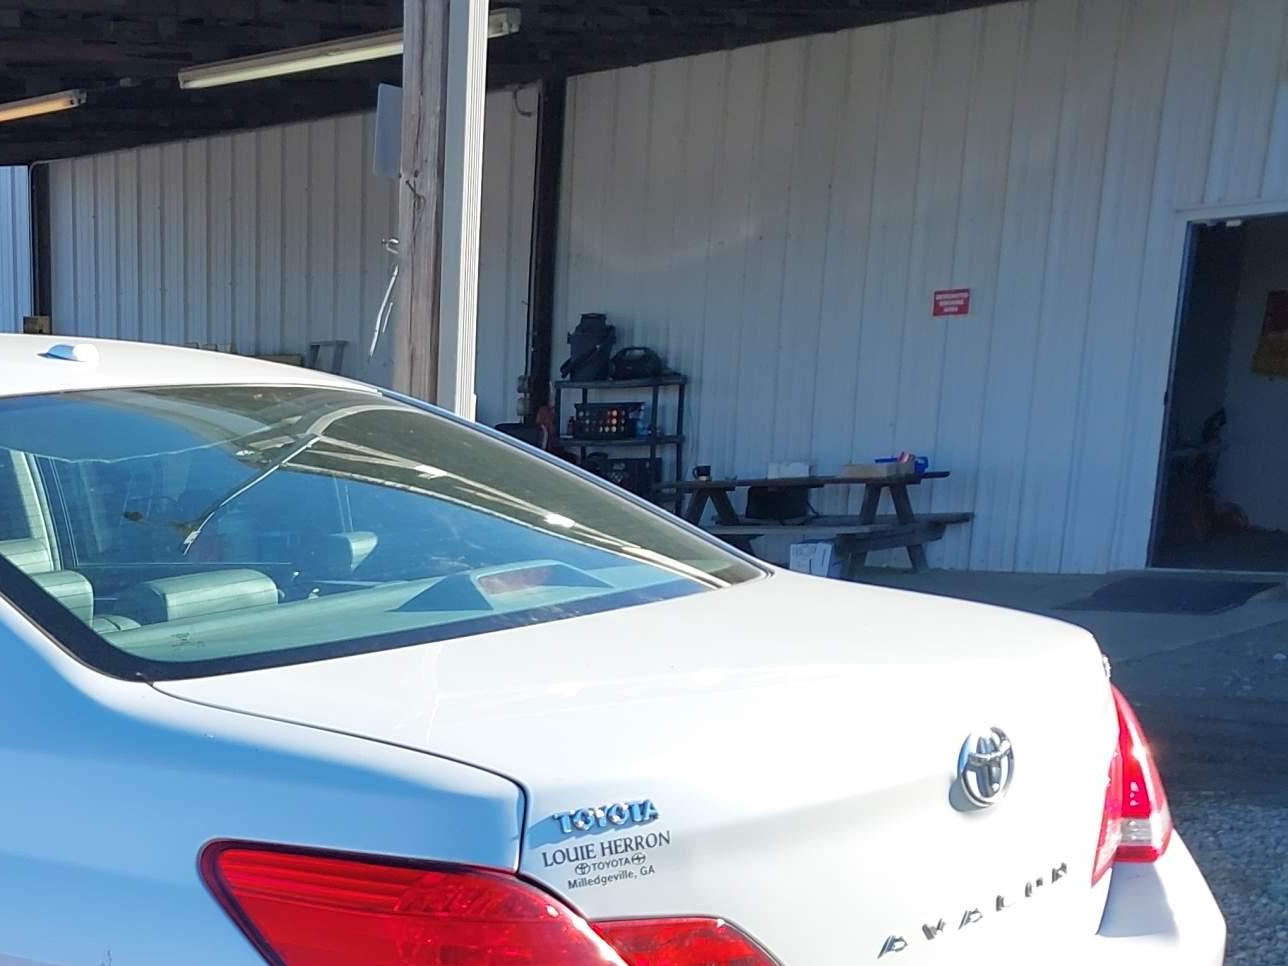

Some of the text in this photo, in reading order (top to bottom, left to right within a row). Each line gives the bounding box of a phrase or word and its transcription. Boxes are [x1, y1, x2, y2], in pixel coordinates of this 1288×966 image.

[553, 799, 661, 833] TOYOTA
[542, 830, 671, 868] LOUIE HERRON
[567, 865, 656, 889] Milledgeville, GA
[592, 857, 632, 871] TOYOTA
